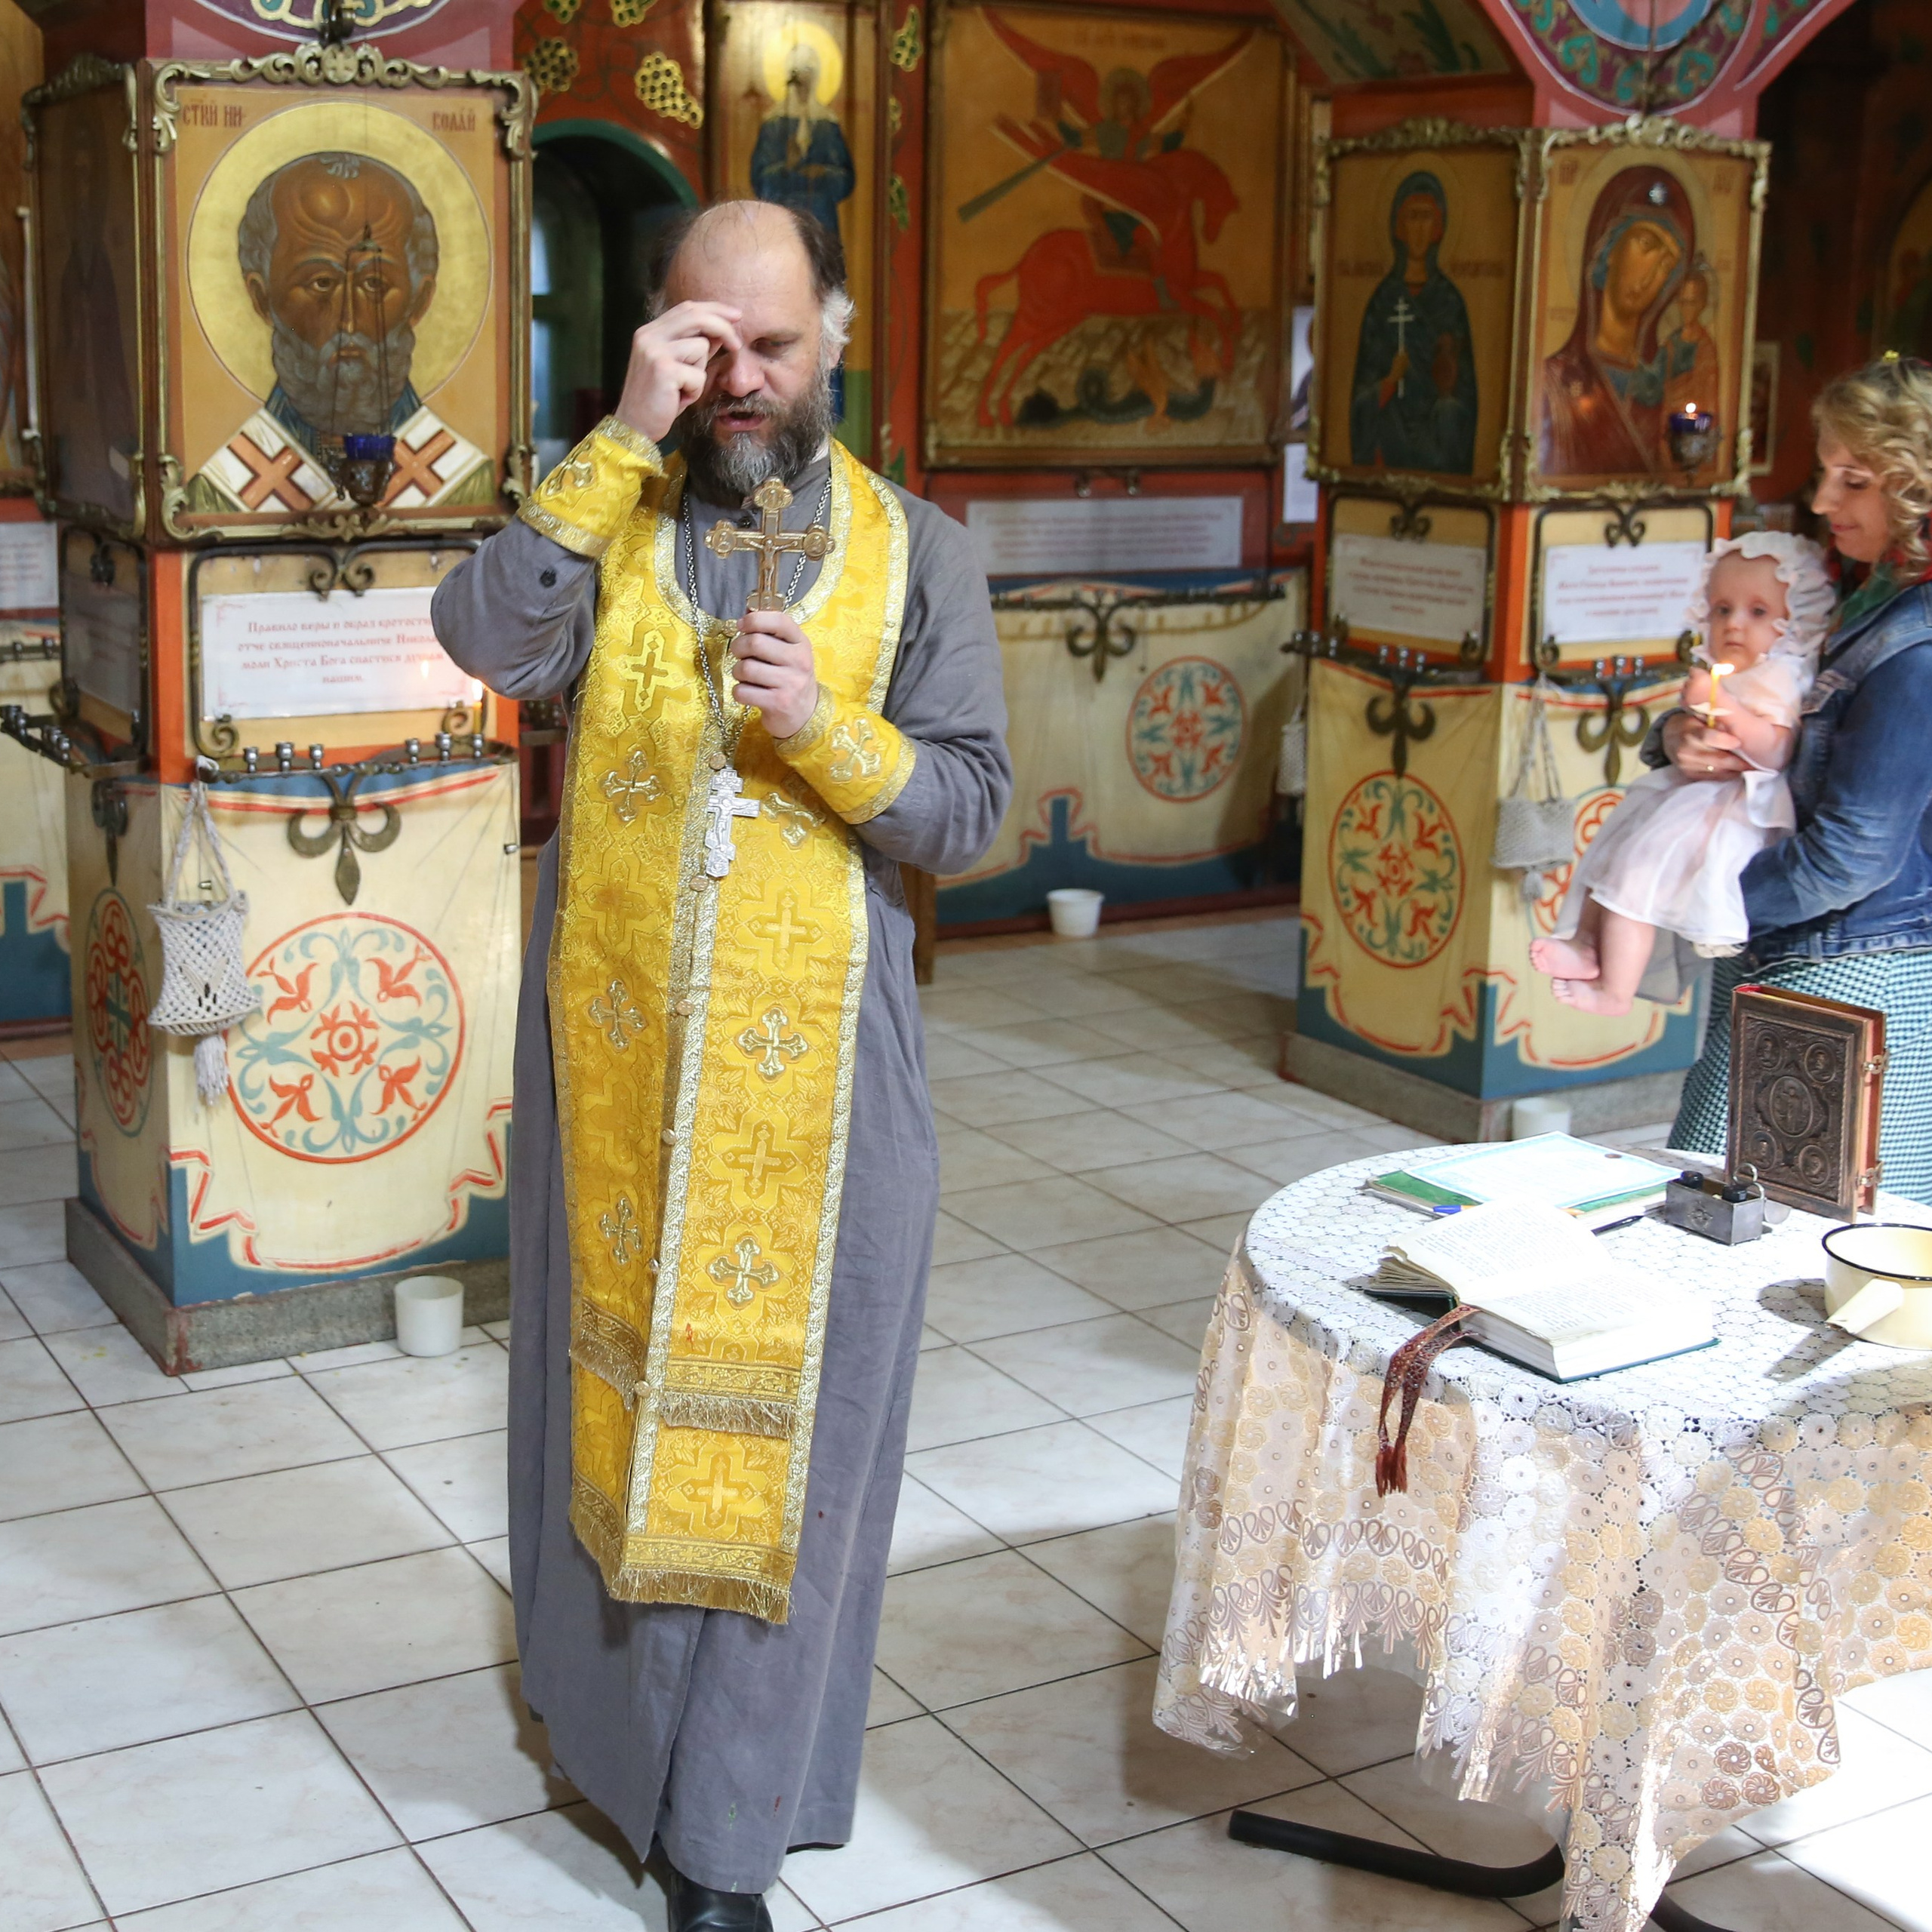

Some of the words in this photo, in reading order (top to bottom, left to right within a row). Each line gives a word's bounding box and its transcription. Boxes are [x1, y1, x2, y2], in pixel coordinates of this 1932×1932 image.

[248, 622, 297, 634] Правило
[301, 622, 330, 632] веры
[238, 643, 264, 651] отче
[242, 661, 270, 669] моли
[274, 656, 317, 669] Христа
[320, 654, 346, 666] Бога
